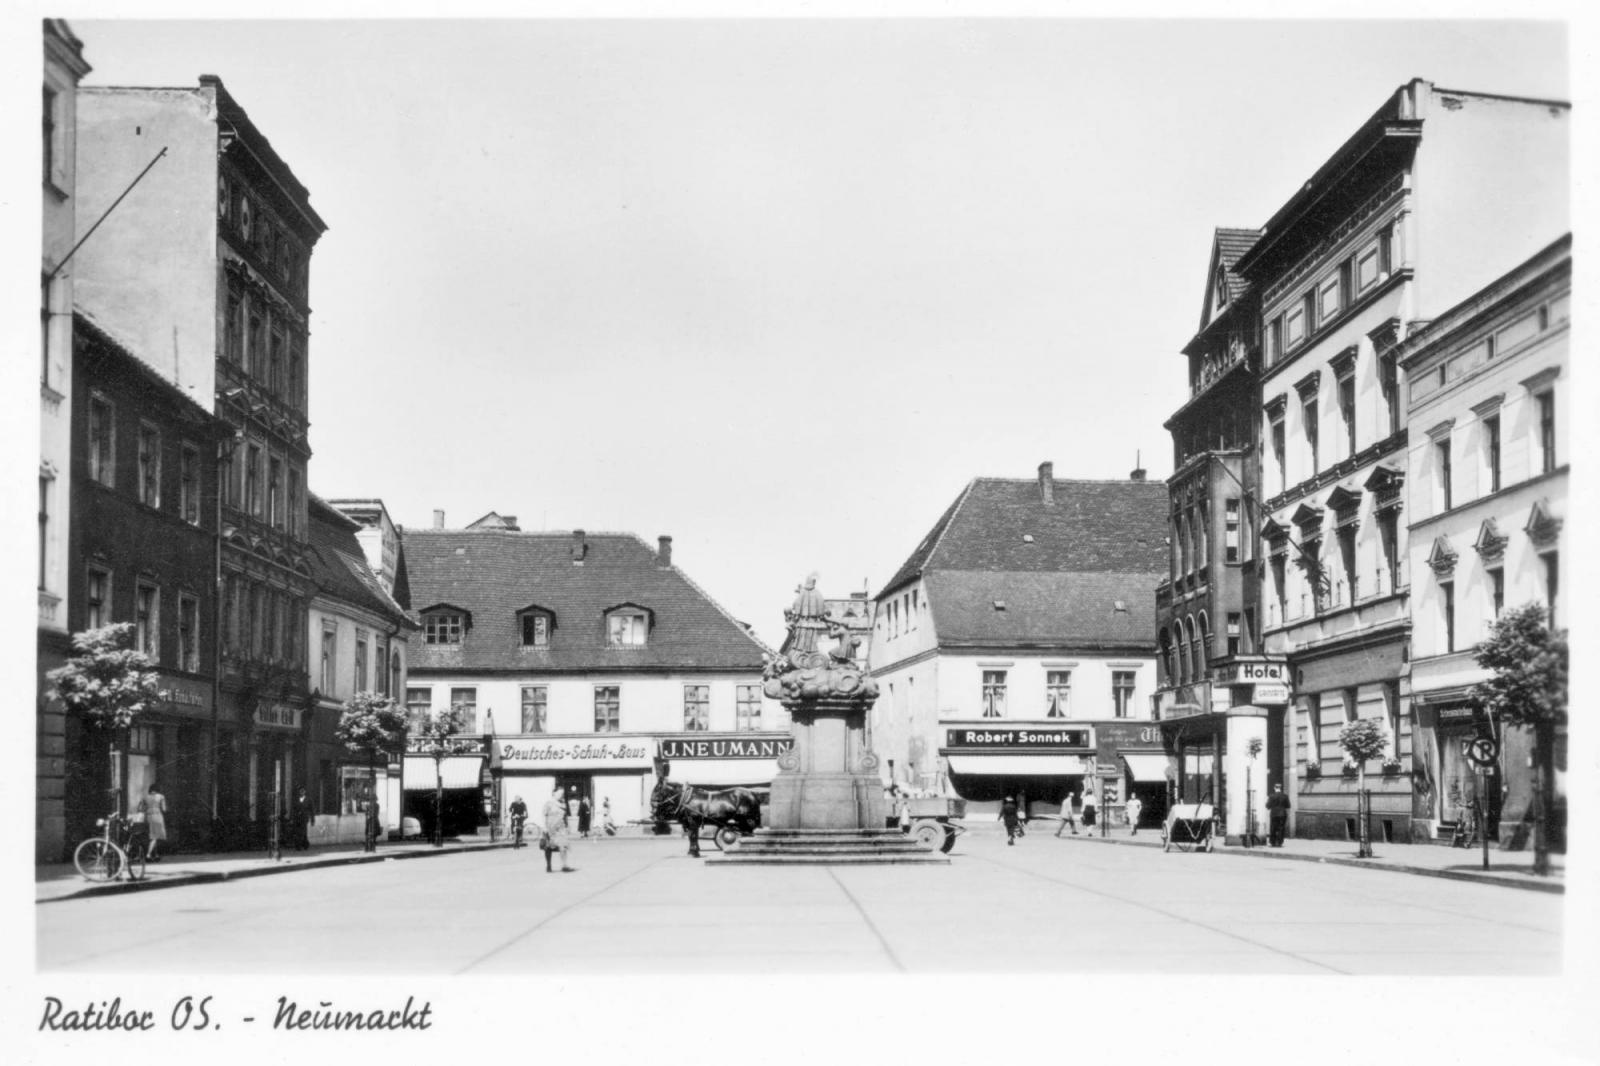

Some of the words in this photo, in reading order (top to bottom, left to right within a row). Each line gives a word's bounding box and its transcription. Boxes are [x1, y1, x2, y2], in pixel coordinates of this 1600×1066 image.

[1244, 663, 1282, 679] Hotel
[966, 731, 1014, 743] Robert
[1018, 731, 1070, 743] Sonnek
